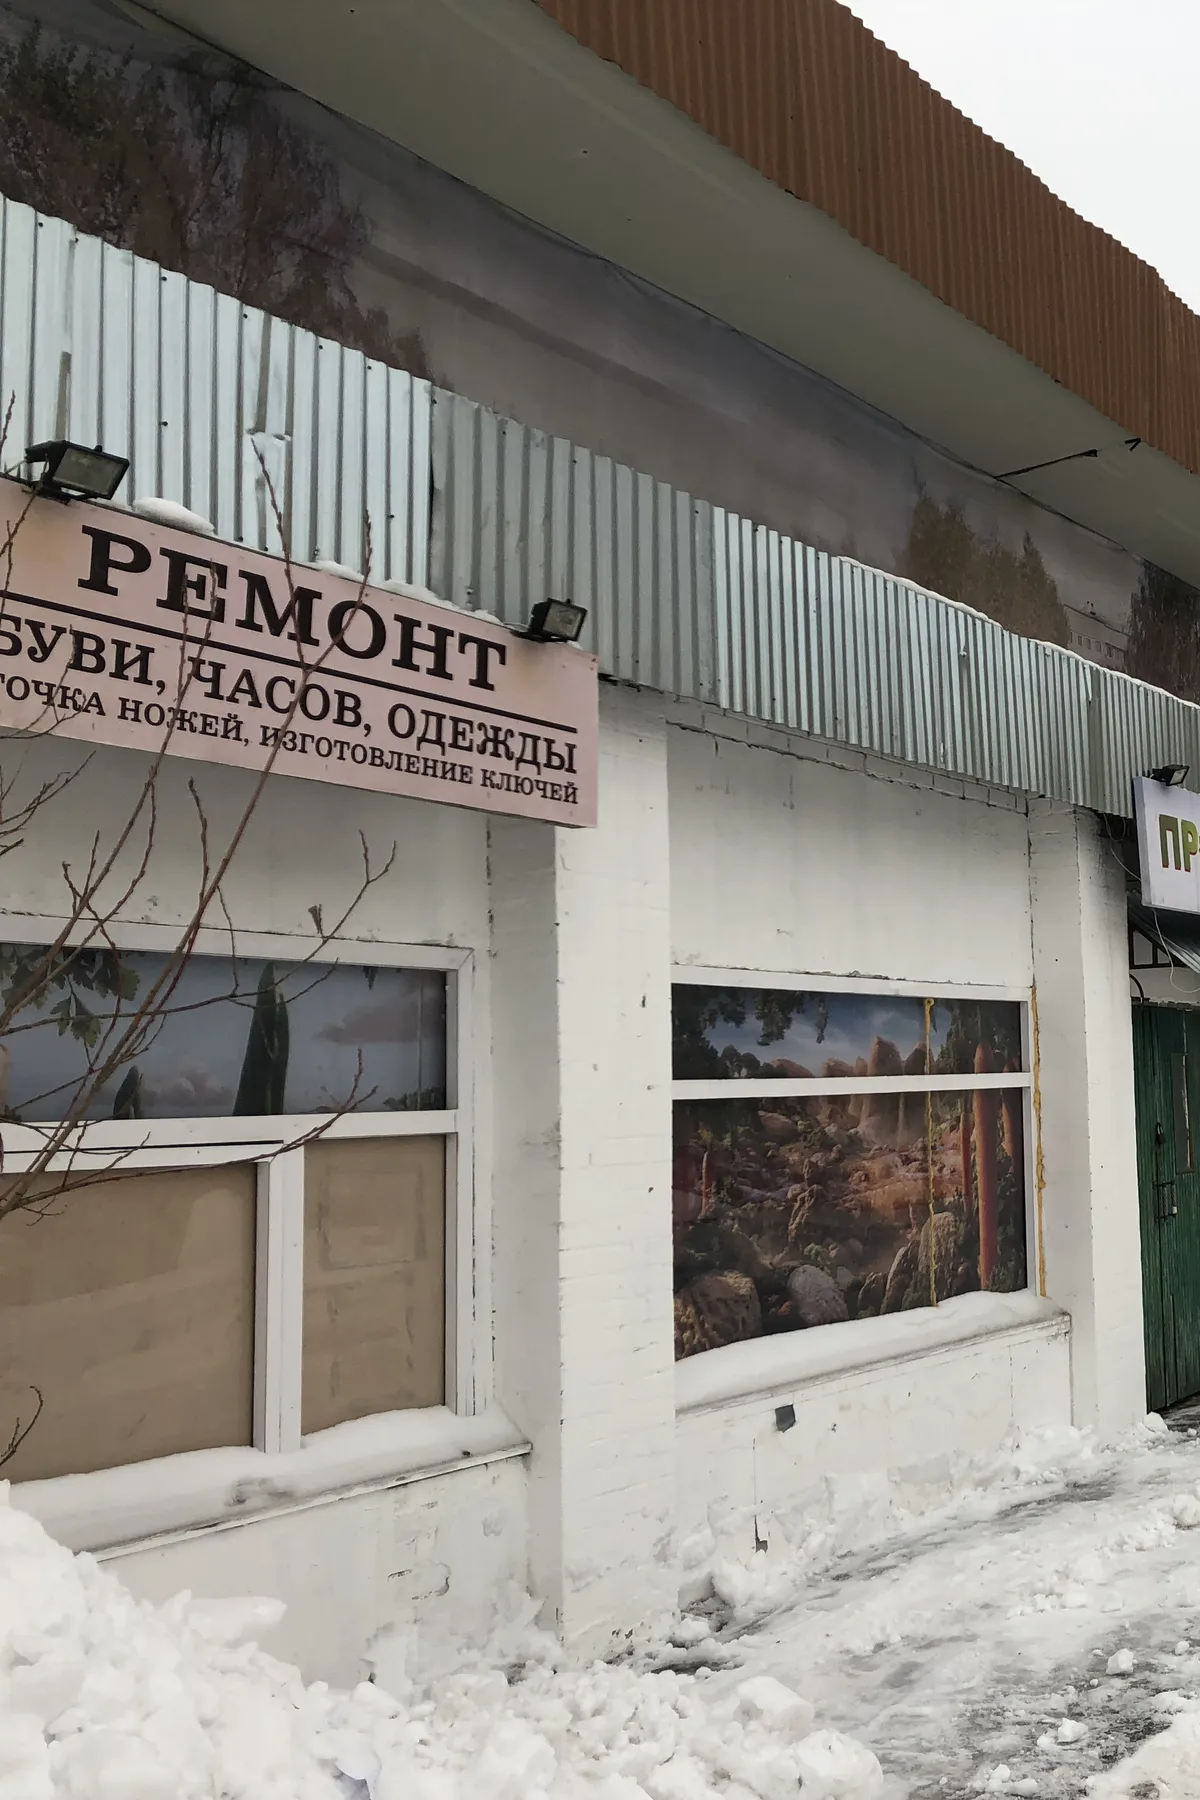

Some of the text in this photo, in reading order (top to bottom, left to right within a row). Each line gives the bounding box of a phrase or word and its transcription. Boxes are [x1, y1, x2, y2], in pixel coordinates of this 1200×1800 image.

[78, 525, 507, 691] РЕМОНТ
[0, 614, 577, 774] БУВИ, ЧАСОВ, ОДЕЖДЫ
[0, 673, 579, 804] ОЧКА НОЖЕЙ, ИЗГОТОВЛЕНИЕ КЛЮЧЕЙ
